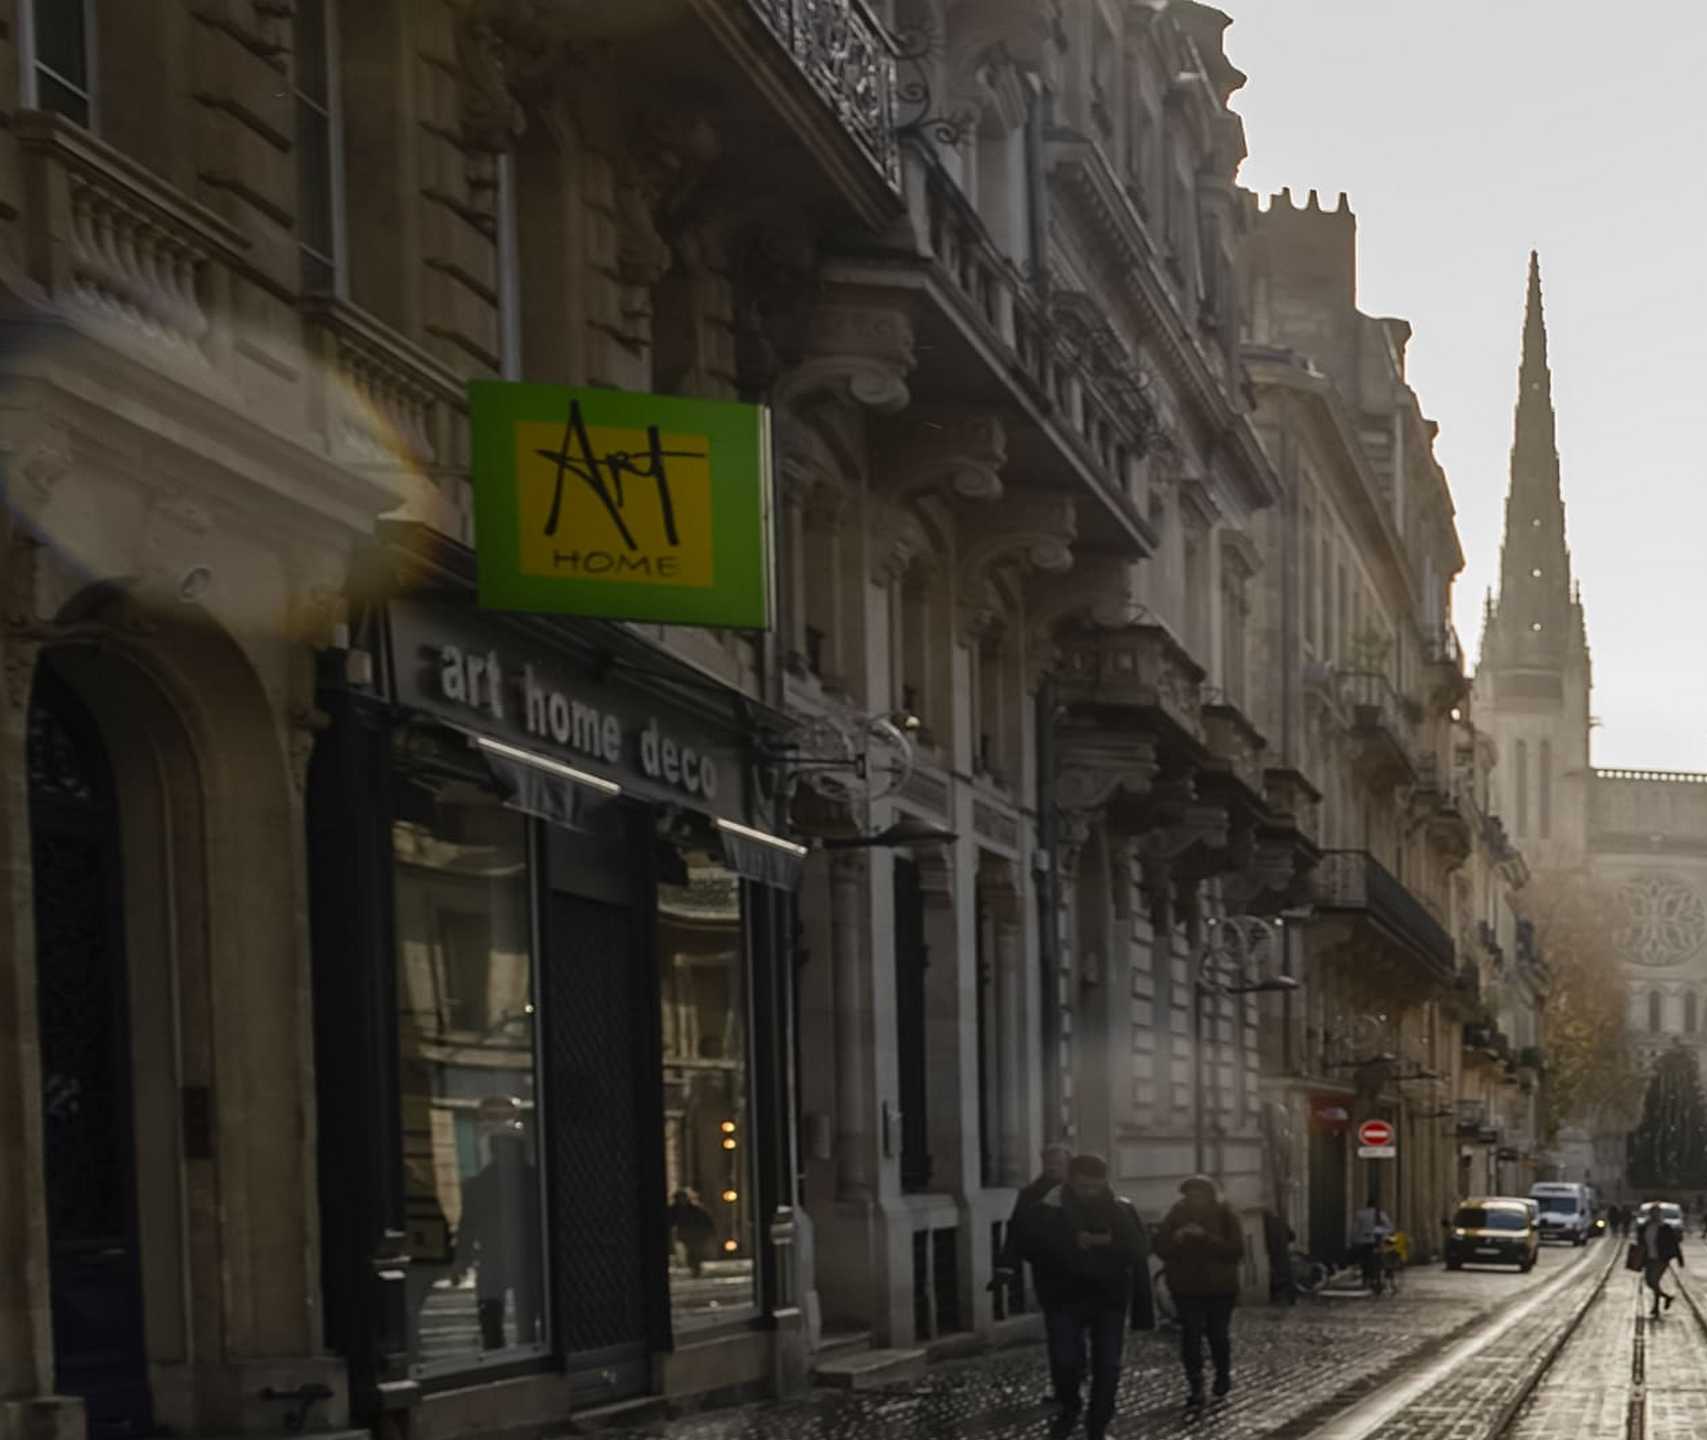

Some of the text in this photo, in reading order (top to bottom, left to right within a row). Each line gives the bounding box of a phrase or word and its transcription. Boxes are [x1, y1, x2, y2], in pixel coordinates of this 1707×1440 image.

[536, 399, 706, 551] Art
[553, 551, 680, 577] HOME
[441, 645, 719, 799] art home deco
